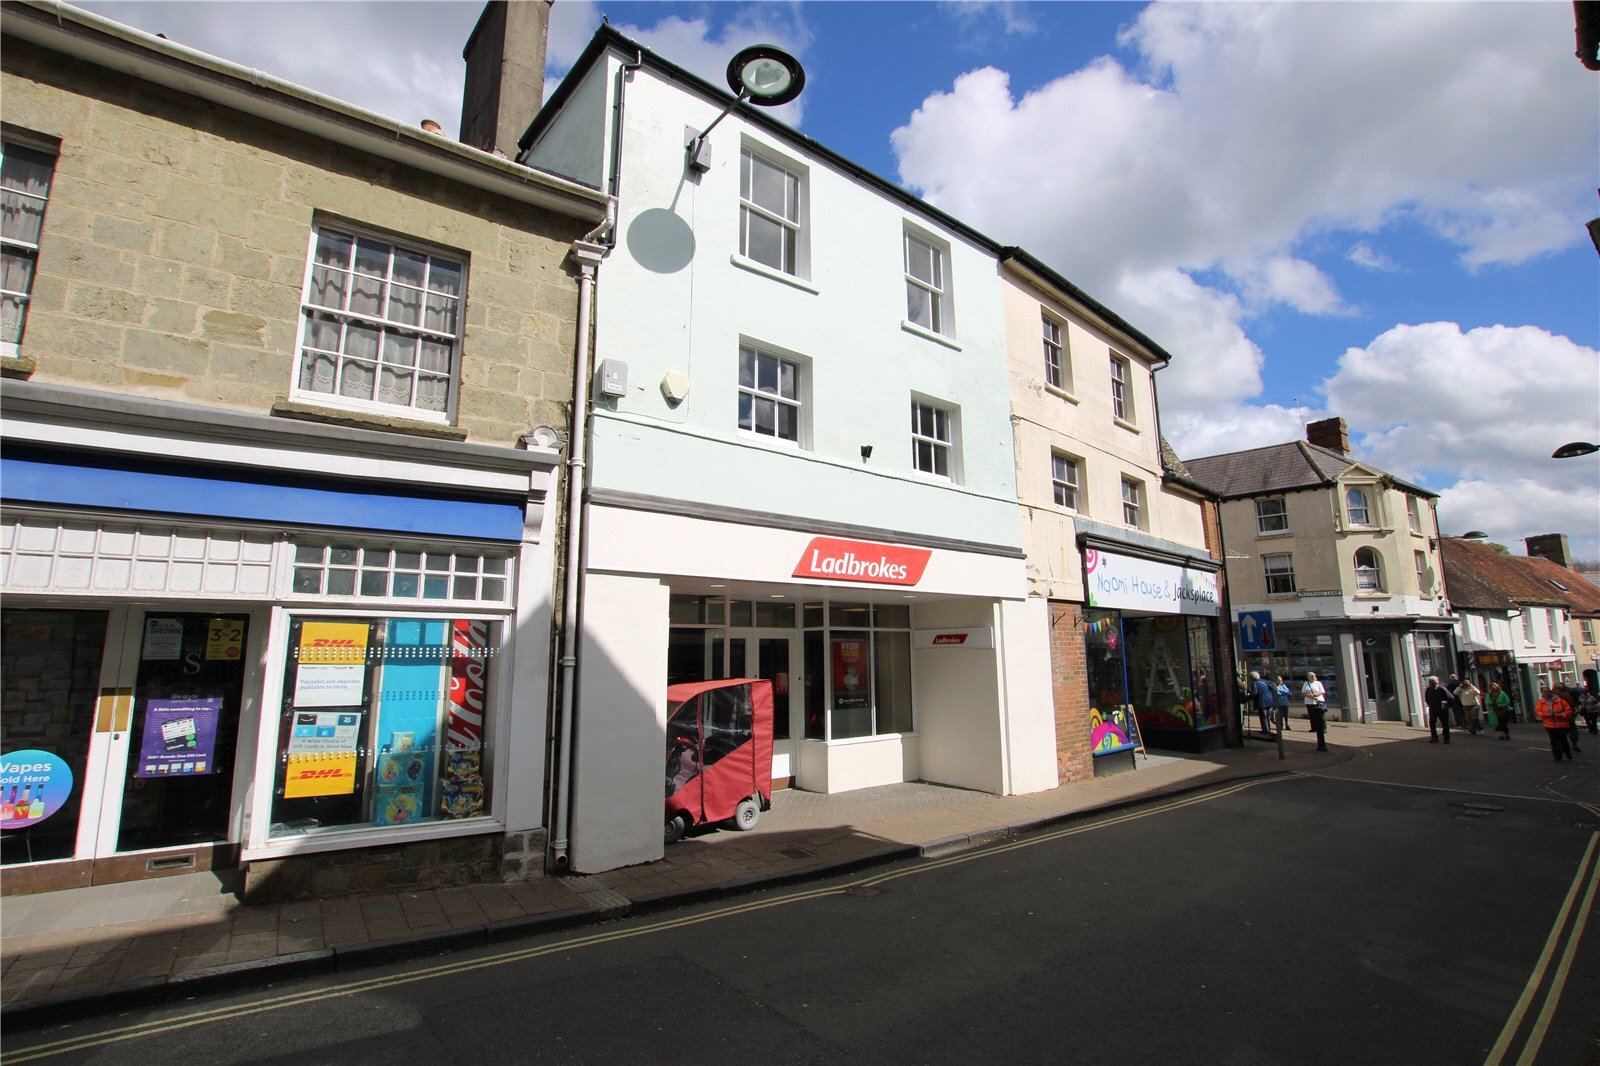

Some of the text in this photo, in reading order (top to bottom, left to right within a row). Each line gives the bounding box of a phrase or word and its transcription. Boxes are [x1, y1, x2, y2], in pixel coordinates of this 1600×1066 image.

[810, 549, 907, 579] Ladbrokes
[1097, 571, 1214, 604] Naomi House & Jacksplace
[151, 627, 181, 635] BROWN
[210, 628, 241, 642] 3 2
[313, 639, 355, 647] DHL
[935, 635, 960, 644] Ladbrokes
[0, 763, 52, 775] Vapes
[299, 769, 344, 780] DHL
[0, 776, 20, 784] old
